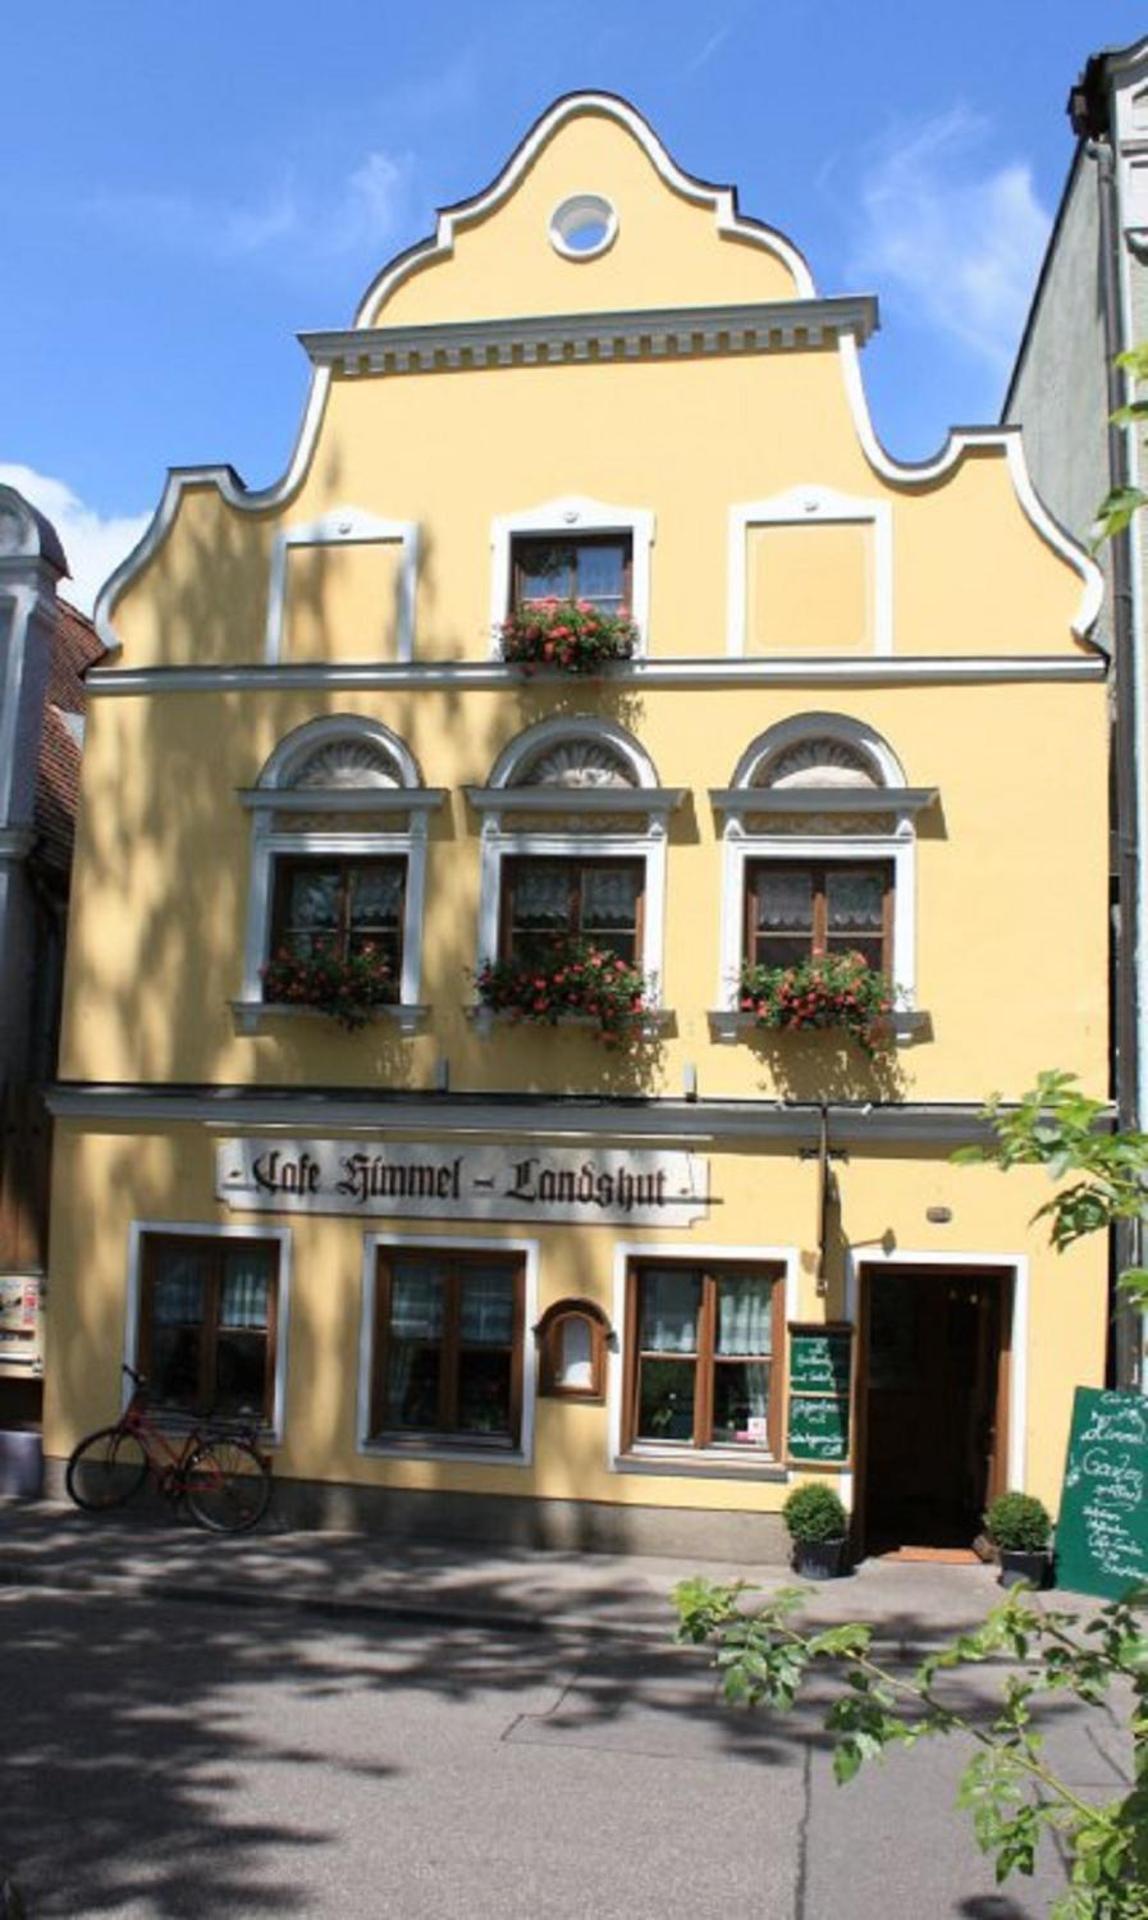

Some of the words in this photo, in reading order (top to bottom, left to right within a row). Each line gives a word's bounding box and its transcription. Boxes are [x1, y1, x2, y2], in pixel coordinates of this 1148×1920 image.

[253, 1150, 320, 1195] Cafe
[338, 1152, 463, 1204] Himmel
[505, 1158, 666, 1212] Landshut
